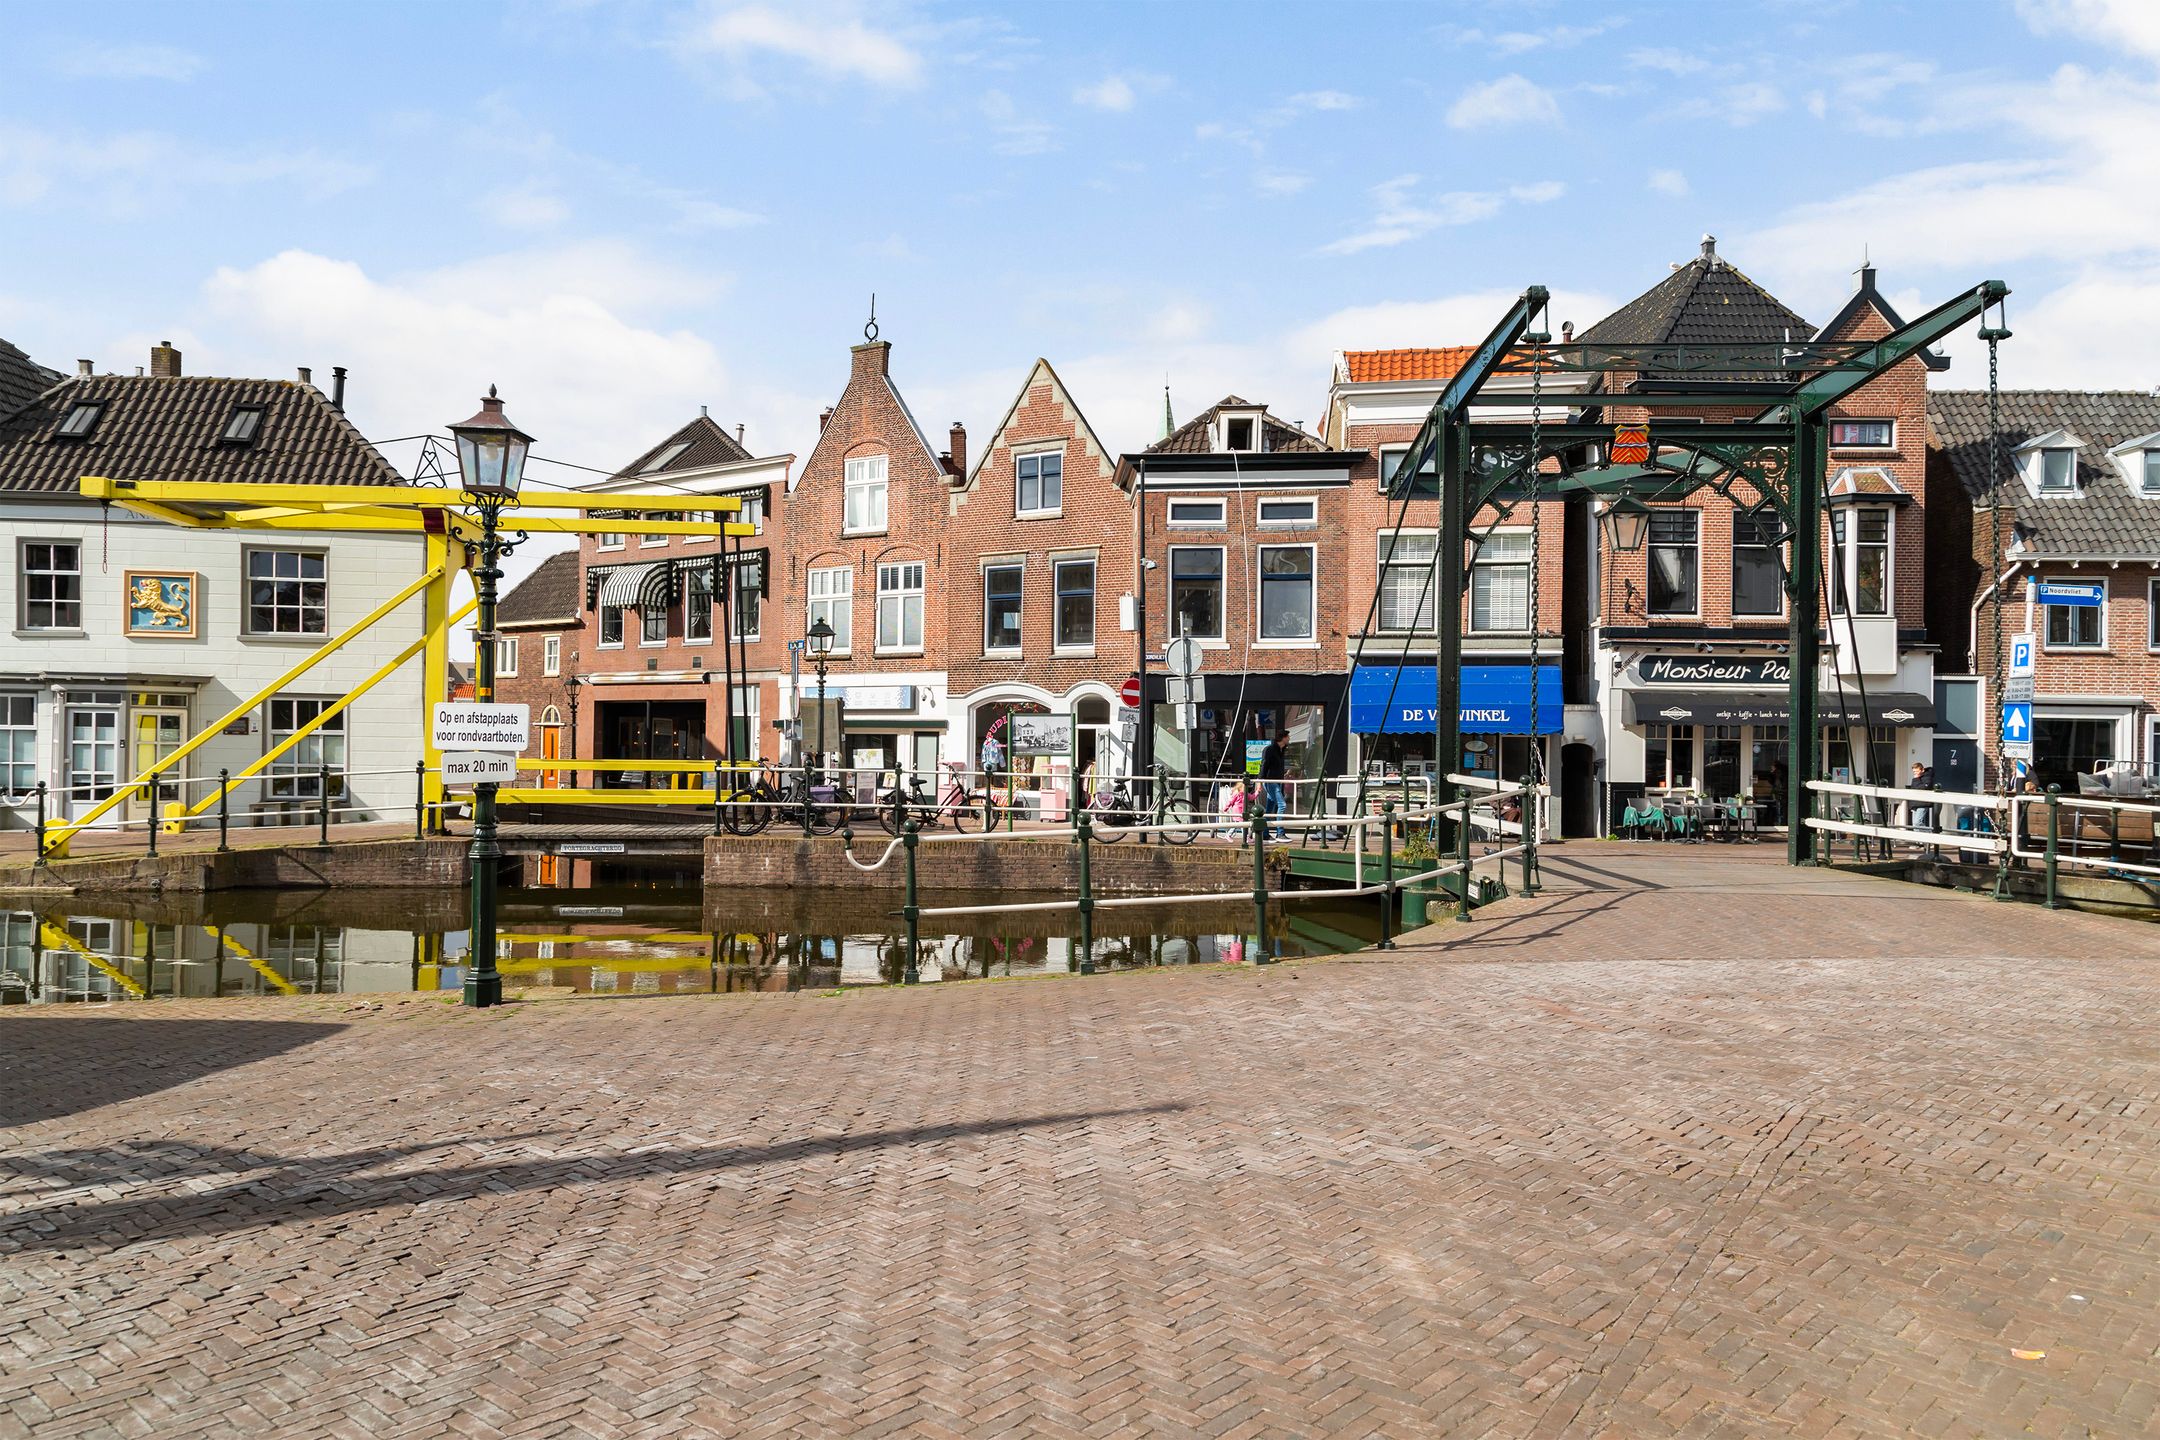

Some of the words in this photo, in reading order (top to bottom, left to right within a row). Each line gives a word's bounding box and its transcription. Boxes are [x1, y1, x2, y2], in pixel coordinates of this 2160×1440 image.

[2016, 645, 2028, 666] P
[1651, 658, 1751, 679] Monsieur
[1760, 660, 1790, 680] Pa
[439, 711, 452, 726] Op
[454, 714, 465, 724] en
[466, 712, 519, 727] afstapplaats
[1403, 709, 1424, 721] DE
[436, 731, 456, 741] voor
[457, 730, 525, 743] rondvaartboten.
[1950, 749, 1957, 759] 7
[447, 763, 470, 774] max
[473, 760, 485, 773] 20
[488, 759, 508, 772] min
